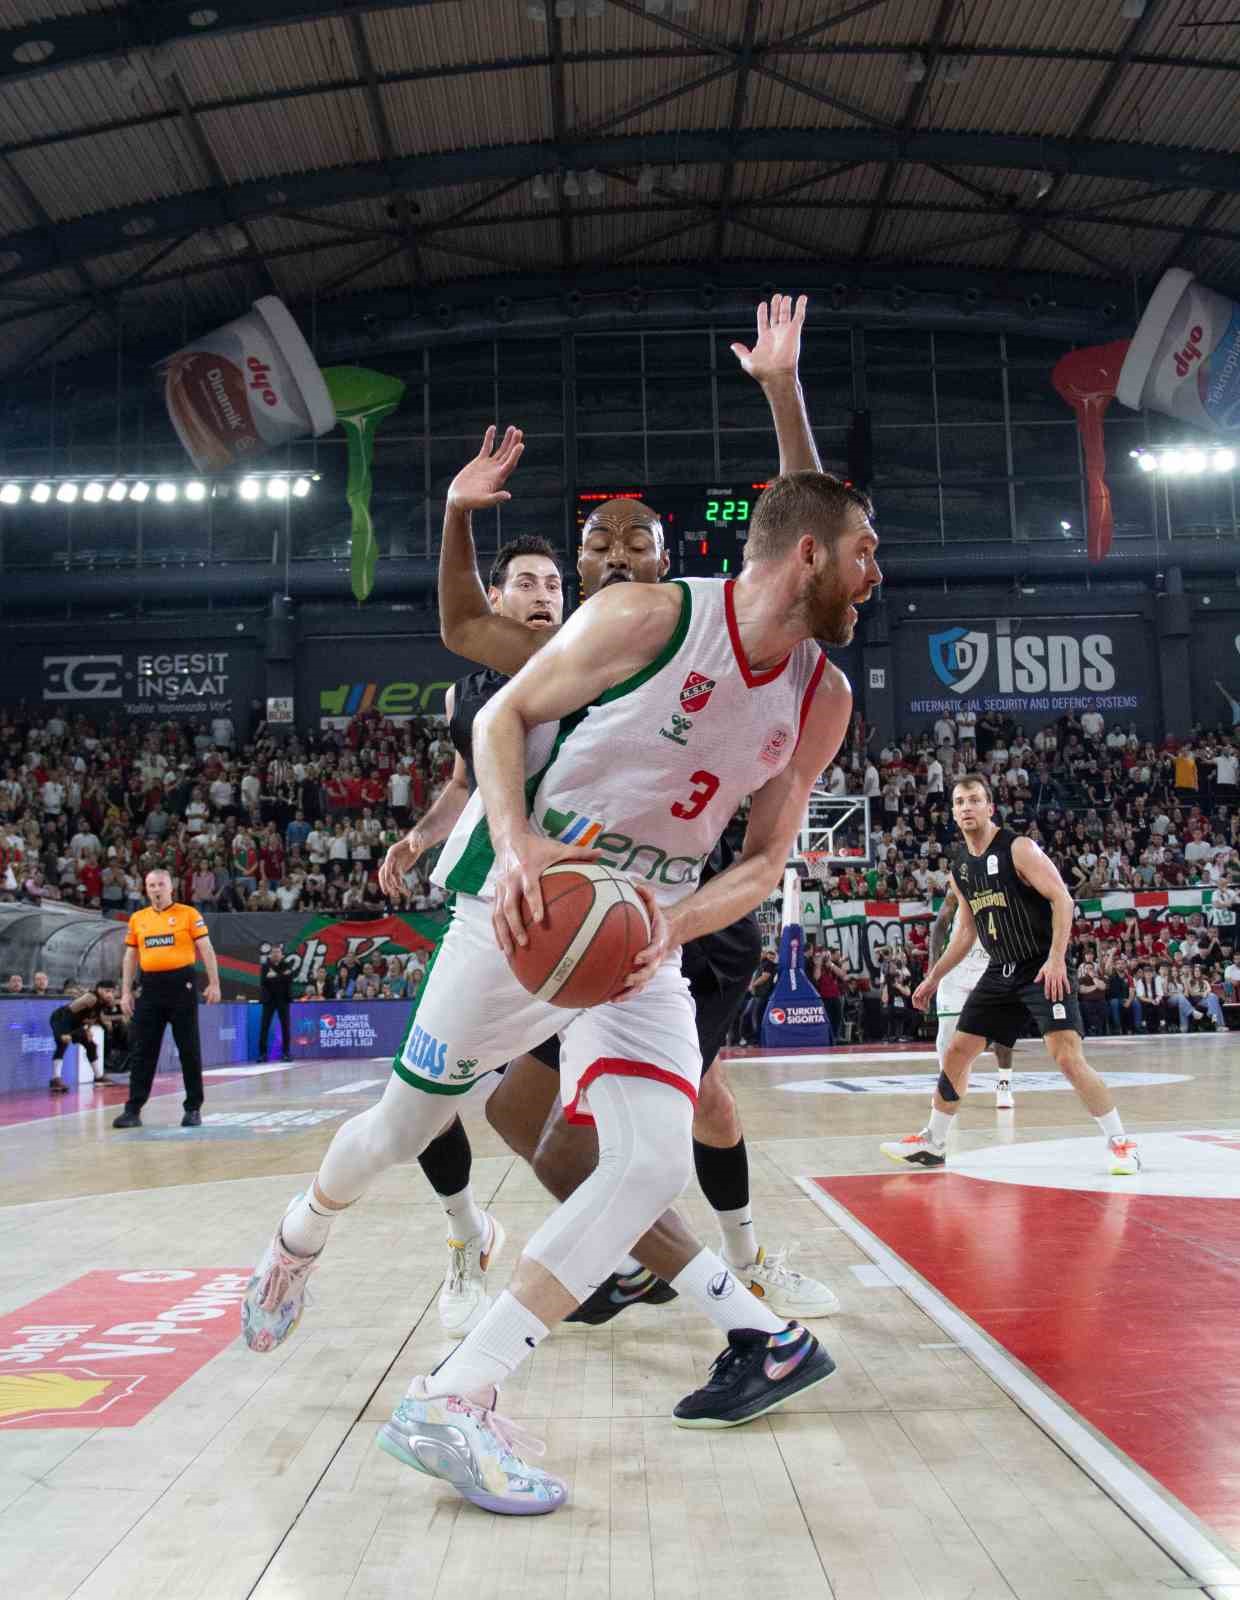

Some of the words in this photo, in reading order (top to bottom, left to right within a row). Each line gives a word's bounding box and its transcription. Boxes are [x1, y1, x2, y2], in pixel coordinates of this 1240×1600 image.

[1030, 698, 1049, 710] AND
[1052, 697, 1093, 710] DEFENC
[1095, 696, 1137, 709] SYSTEMS
[670, 769, 720, 820] 3
[319, 1029, 377, 1038] BASKETBOL
